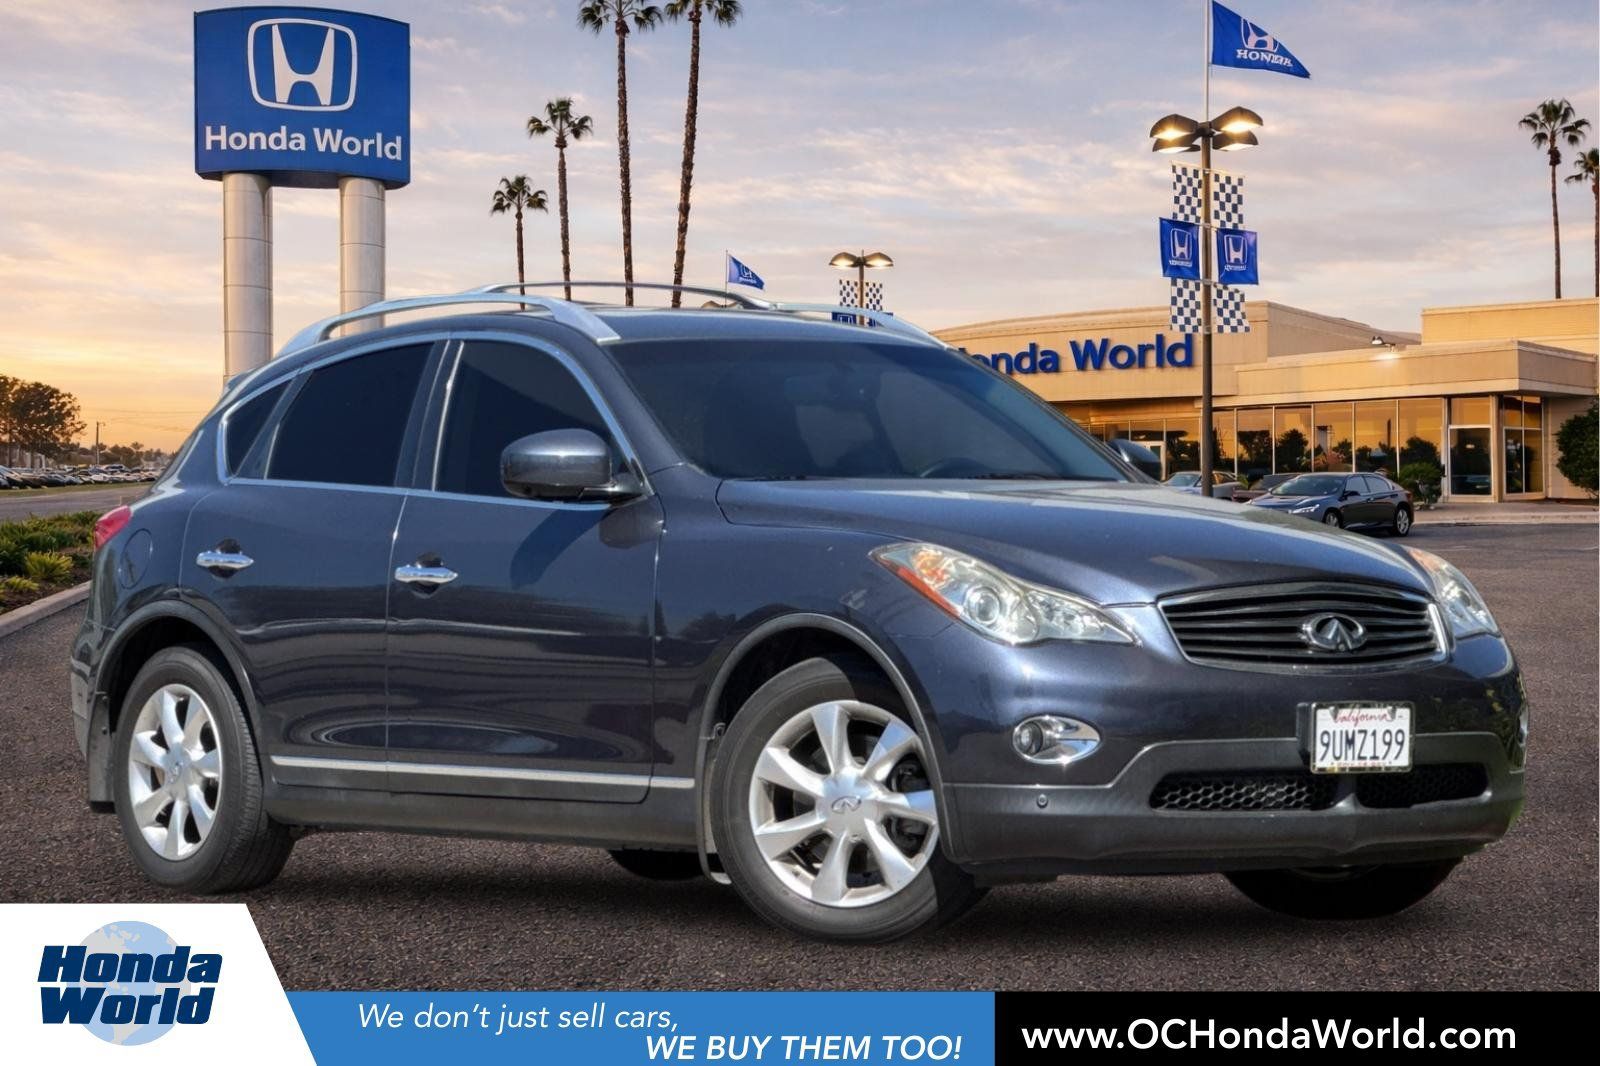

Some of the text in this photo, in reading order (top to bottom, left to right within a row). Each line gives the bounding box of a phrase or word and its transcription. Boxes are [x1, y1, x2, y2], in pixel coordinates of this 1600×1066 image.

[205, 125, 402, 161] Honda World
[958, 333, 1193, 375] nda World
[1320, 729, 1405, 762] 9UMZ199
